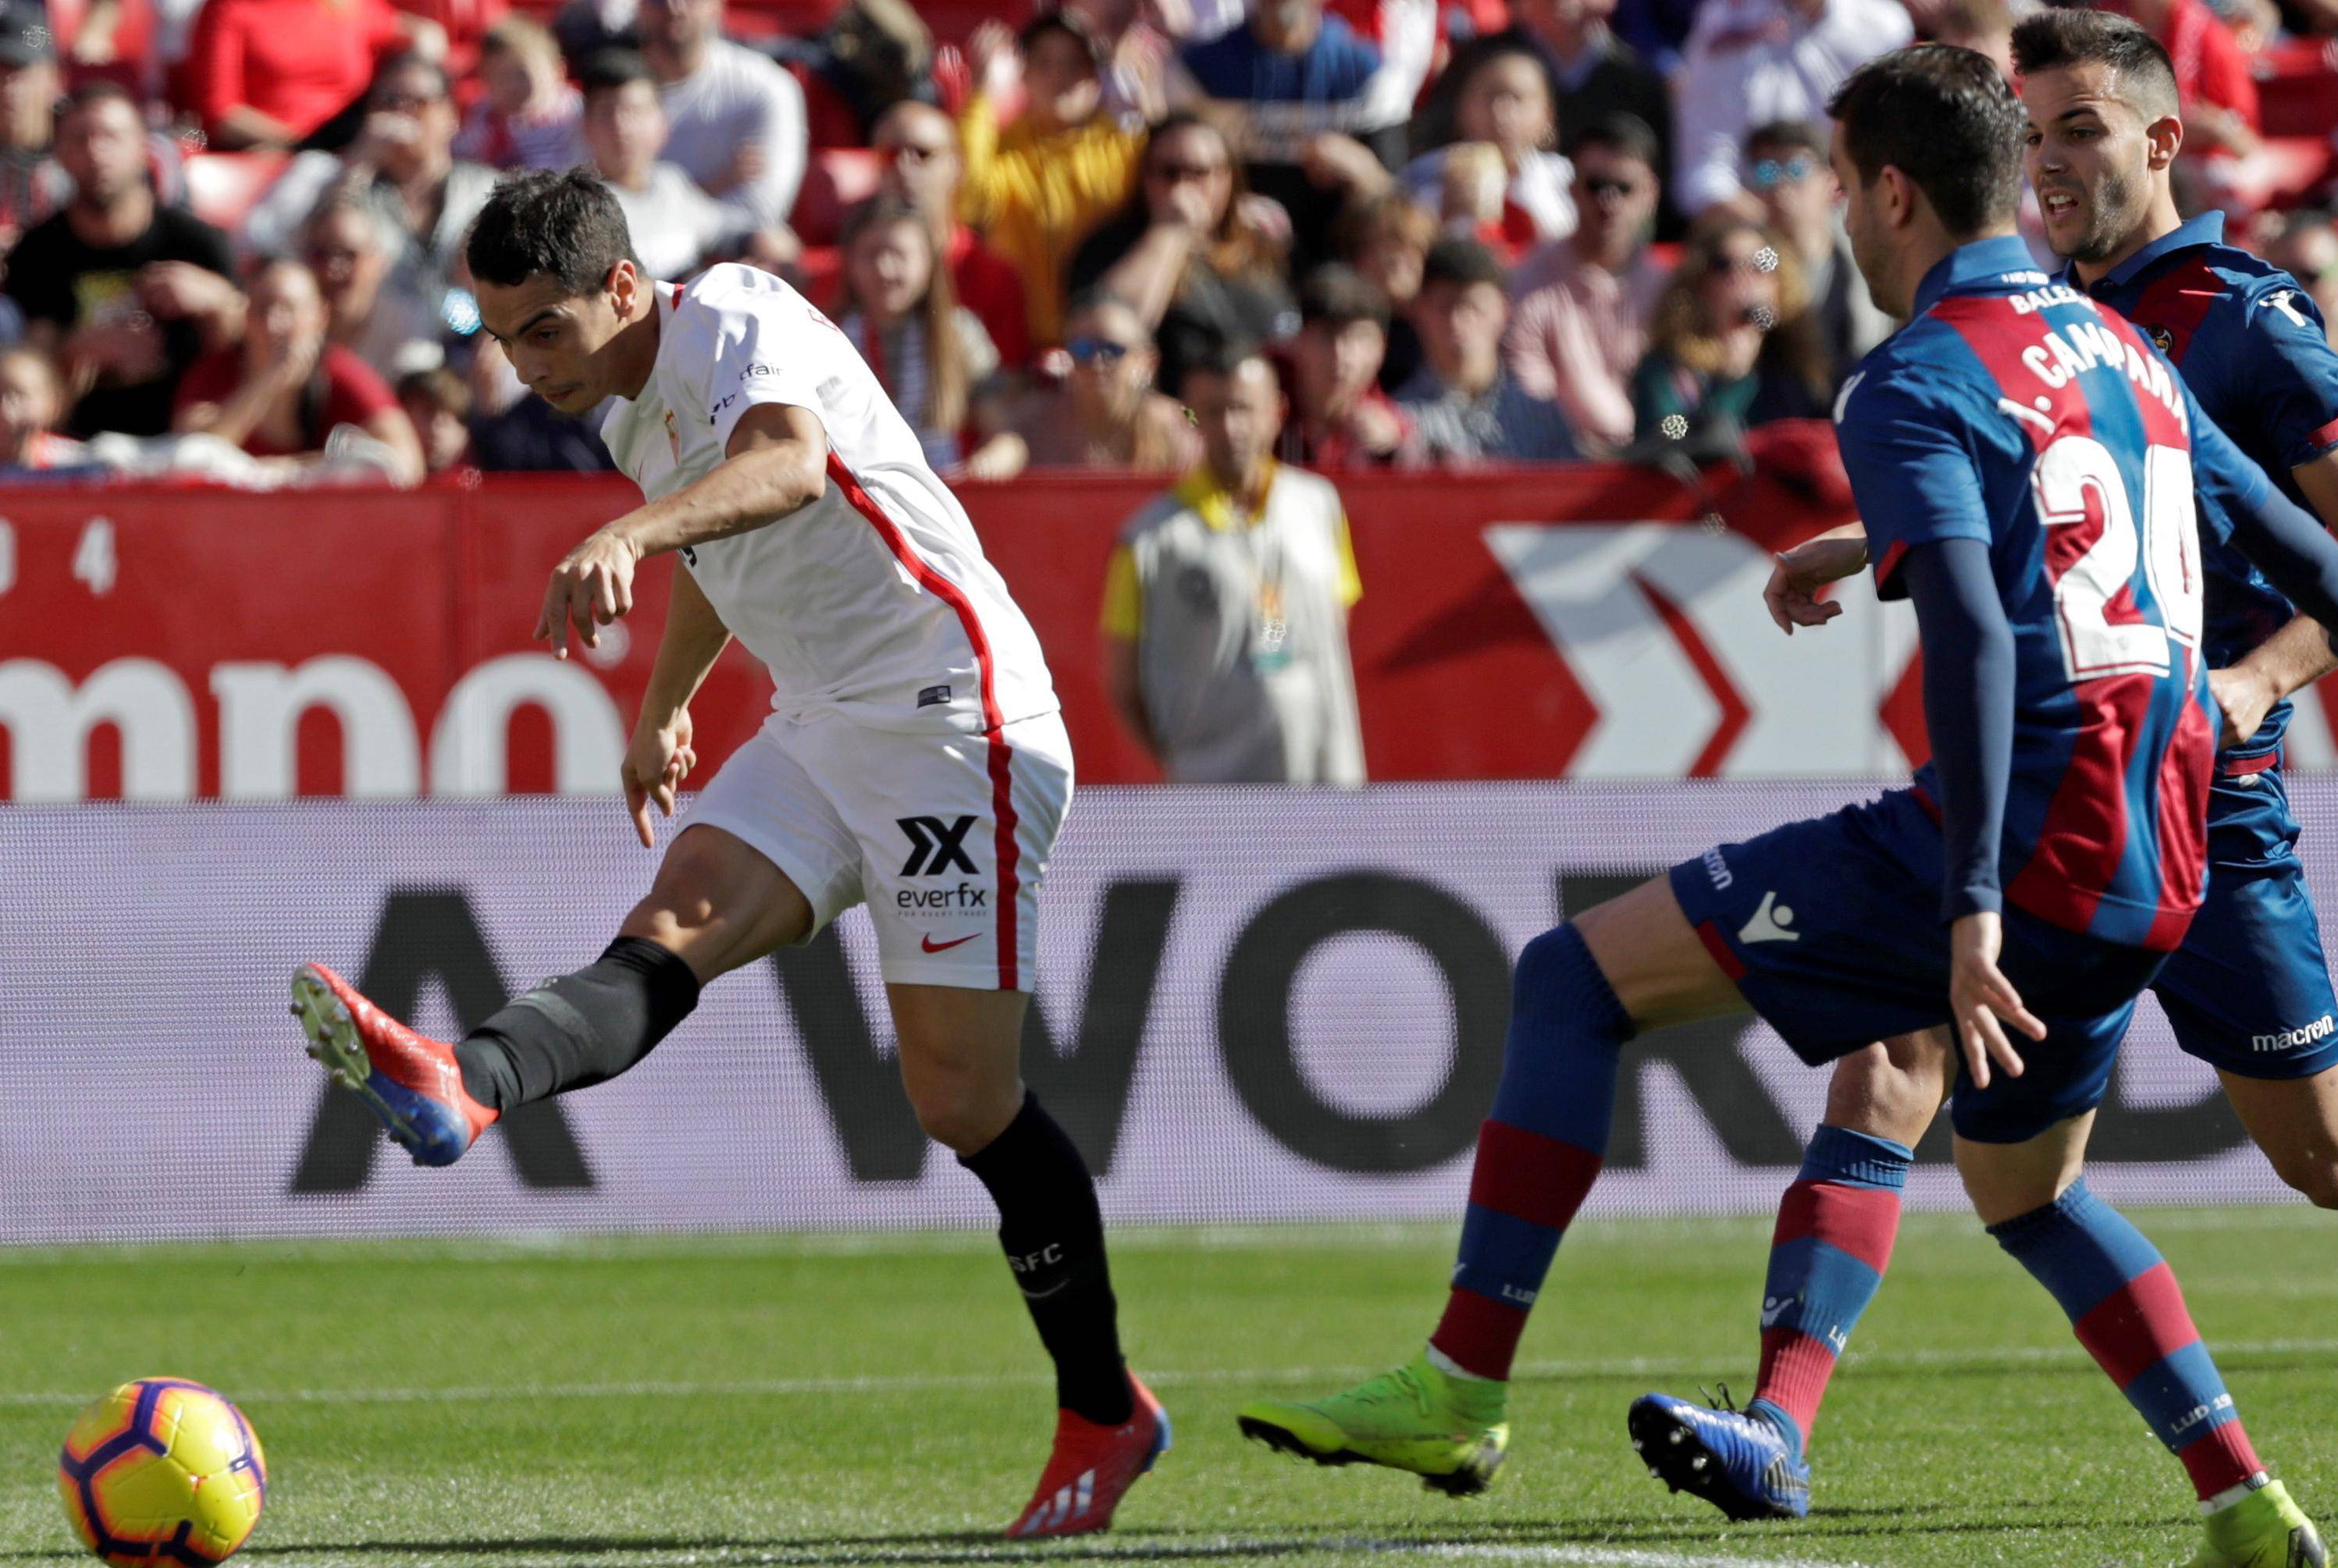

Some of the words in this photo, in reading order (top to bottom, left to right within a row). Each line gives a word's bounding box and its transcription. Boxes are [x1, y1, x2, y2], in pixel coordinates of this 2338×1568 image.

[2030, 435, 2204, 691] 24
[896, 882, 986, 908] everfx
[290, 884, 596, 1192] A
[2251, 1015, 2334, 1051] macron
[1009, 1243, 1063, 1272] SFC
[2171, 1404, 2210, 1435] LUD
